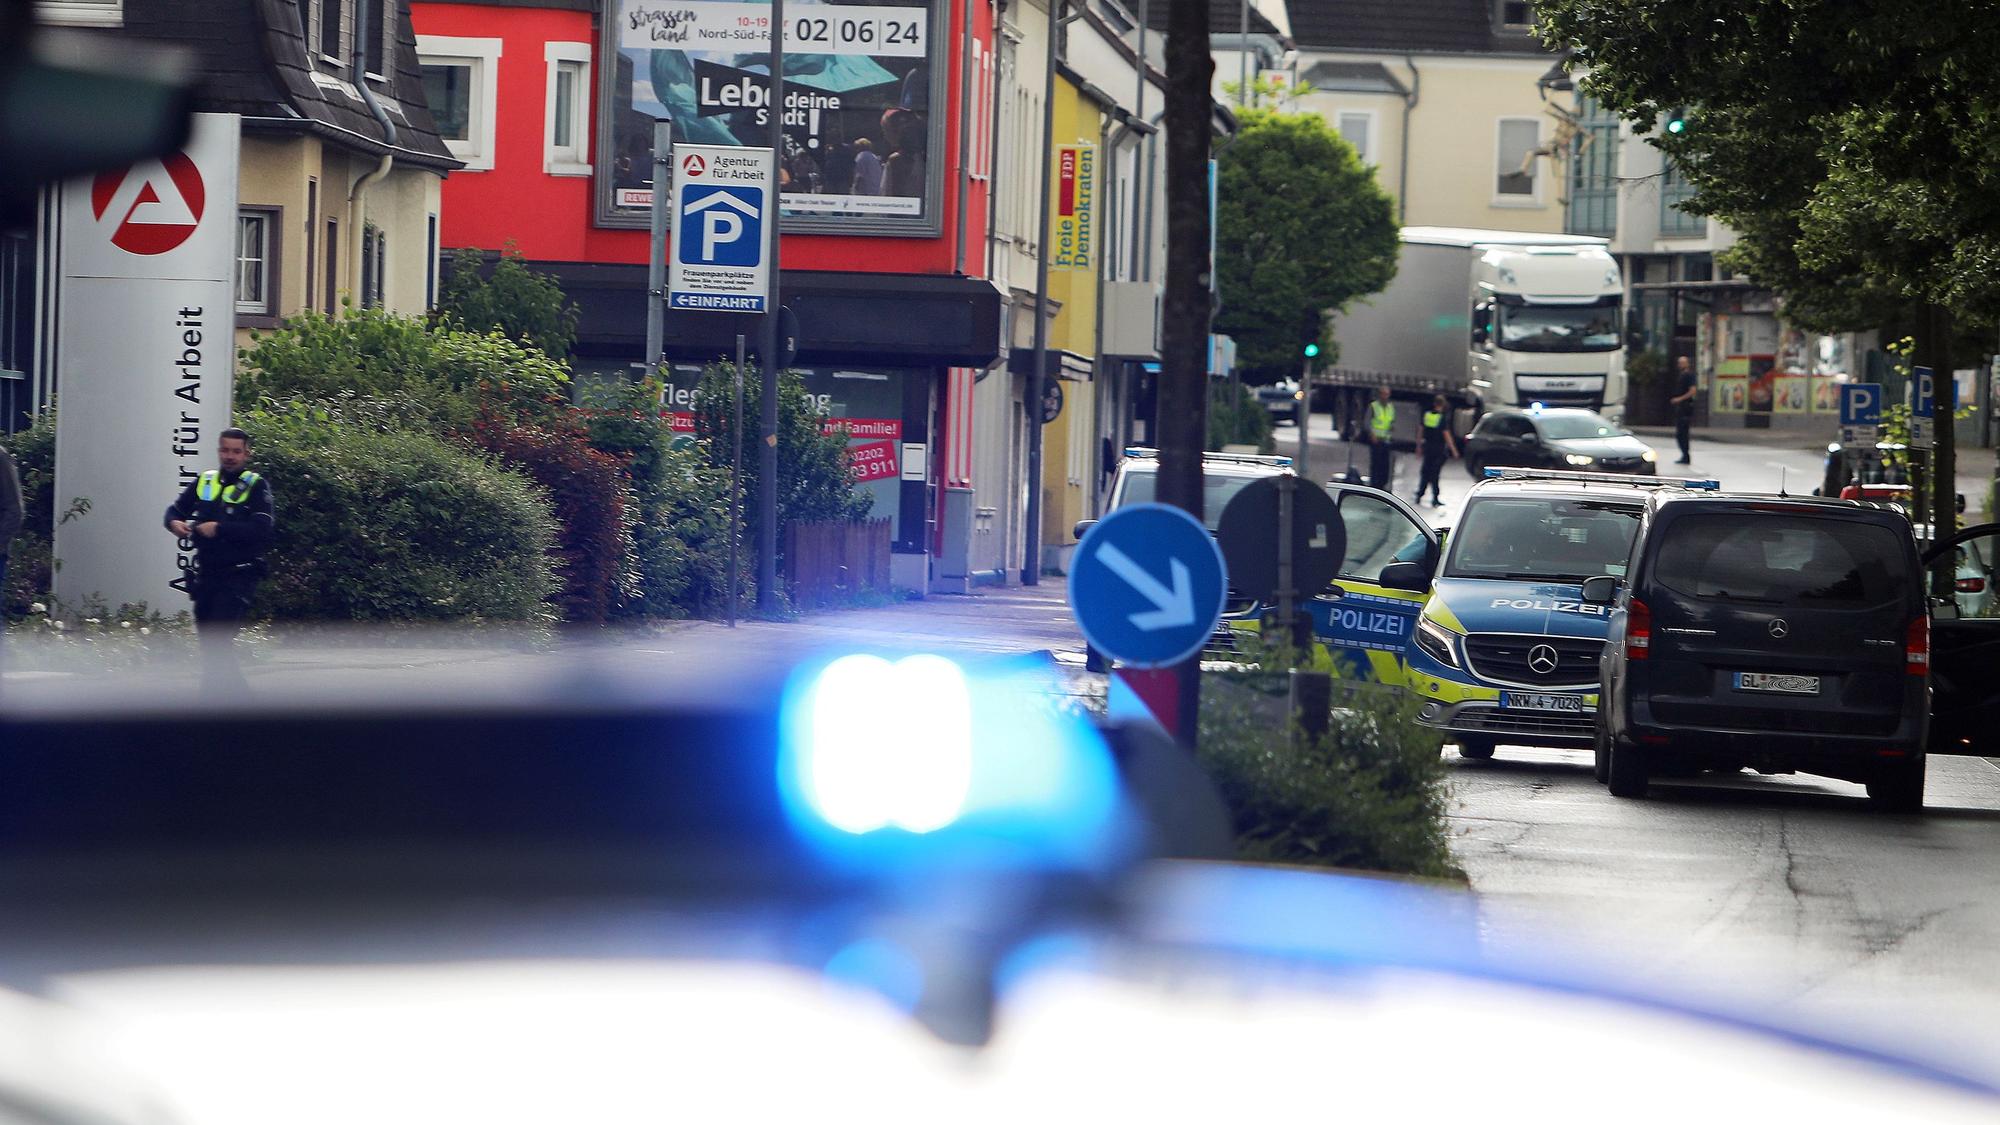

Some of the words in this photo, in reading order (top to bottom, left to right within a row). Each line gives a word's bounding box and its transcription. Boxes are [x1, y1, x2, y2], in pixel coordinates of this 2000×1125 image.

[629, 5, 697, 29] strassen
[651, 24, 689, 43] land
[698, 28, 788, 42] Nord-Süd-Fat
[796, 18, 828, 42] 02
[840, 19, 874, 43] 06
[885, 21, 919, 44] 24
[701, 76, 770, 107] Leb
[784, 91, 840, 110] deine
[714, 155, 760, 169] Agentur
[1062, 153, 1073, 179] FDP
[712, 169, 728, 180] für
[731, 171, 765, 181] Arbeit
[1073, 150, 1093, 267] Demokraten
[702, 210, 743, 262] P
[1056, 219, 1073, 265] Freie
[682, 269, 755, 280] Frauenparkplätze
[688, 295, 760, 309] EINFAHRT
[174, 306, 203, 405] Arbeit
[1918, 374, 1933, 411] P
[1849, 389, 1872, 420] P
[172, 411, 200, 458] für
[845, 421, 897, 435] Familie!
[870, 459, 896, 475] 911
[1490, 599, 1605, 615] POLIZEI
[1329, 607, 1404, 635] POLIZEI
[1742, 674, 1760, 688] GL
[1507, 693, 1531, 708] NRW
